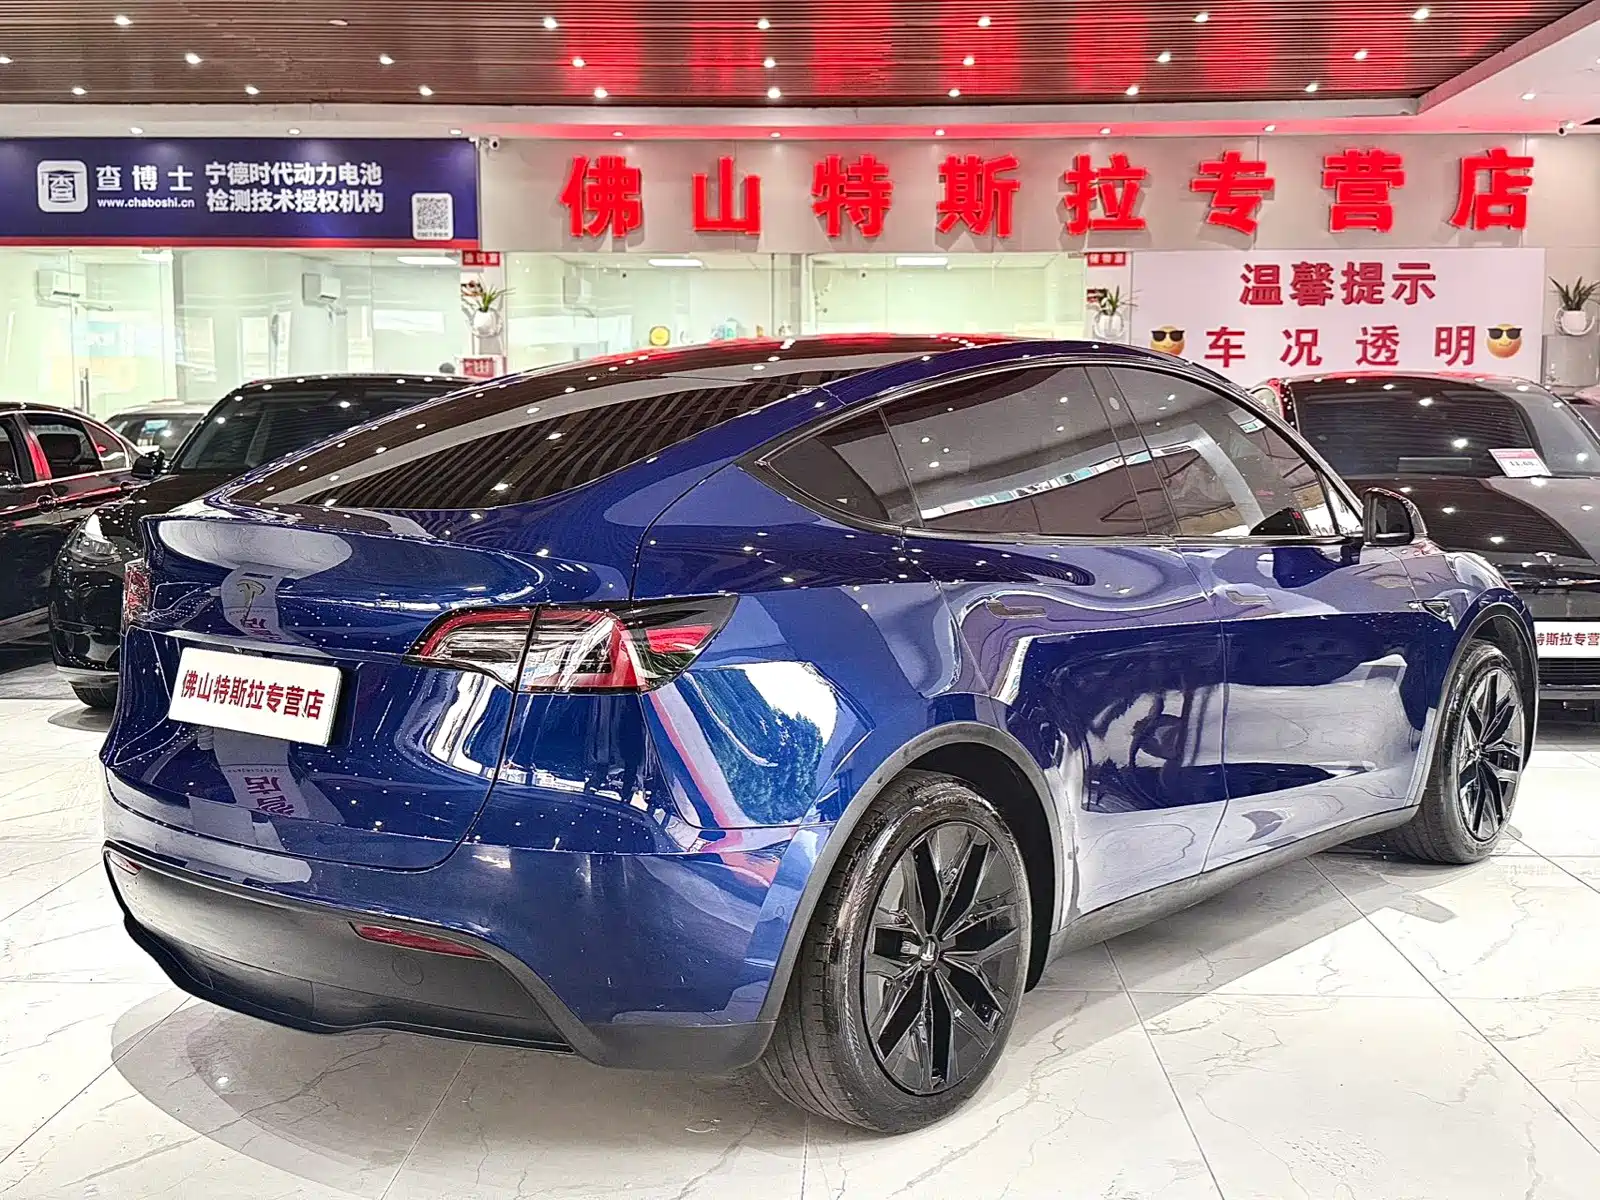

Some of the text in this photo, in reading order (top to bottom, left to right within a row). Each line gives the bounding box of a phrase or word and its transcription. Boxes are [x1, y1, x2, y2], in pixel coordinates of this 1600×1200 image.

[96, 165, 194, 192] 查博士
[205, 161, 383, 186] 宁德时代动力电池
[97, 196, 195, 208] www.chaboshi.cn
[206, 188, 384, 213] 检测技术授权机构
[560, 148, 1535, 238] 佛山特斯拉专营店
[1239, 261, 1437, 307] 温馨提示
[1205, 325, 1476, 368] 车况透明
[180, 669, 326, 720] 佛山特斯拉专营店
